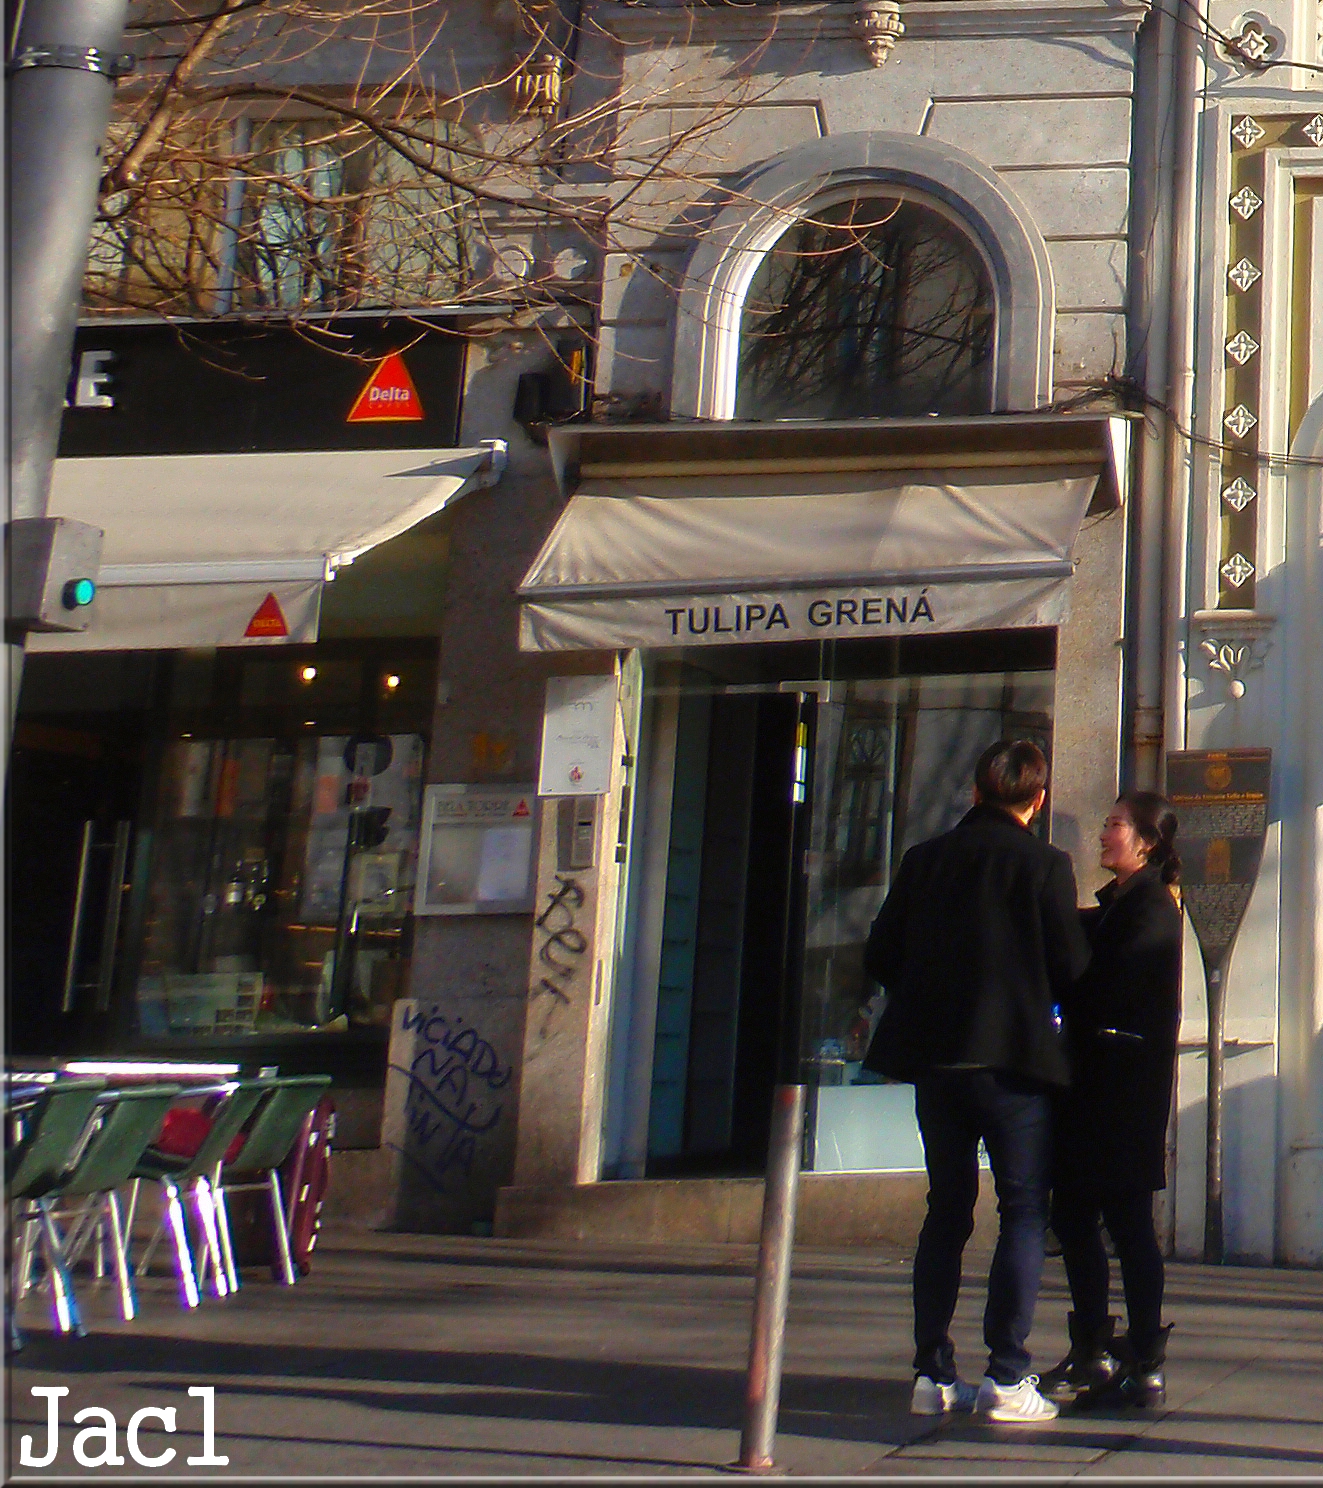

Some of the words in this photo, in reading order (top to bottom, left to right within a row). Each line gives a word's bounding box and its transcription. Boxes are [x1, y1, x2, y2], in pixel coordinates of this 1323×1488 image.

[368, 386, 411, 402] Delta
[664, 603, 791, 635] TULIPA
[807, 588, 935, 627] GRENÁ
